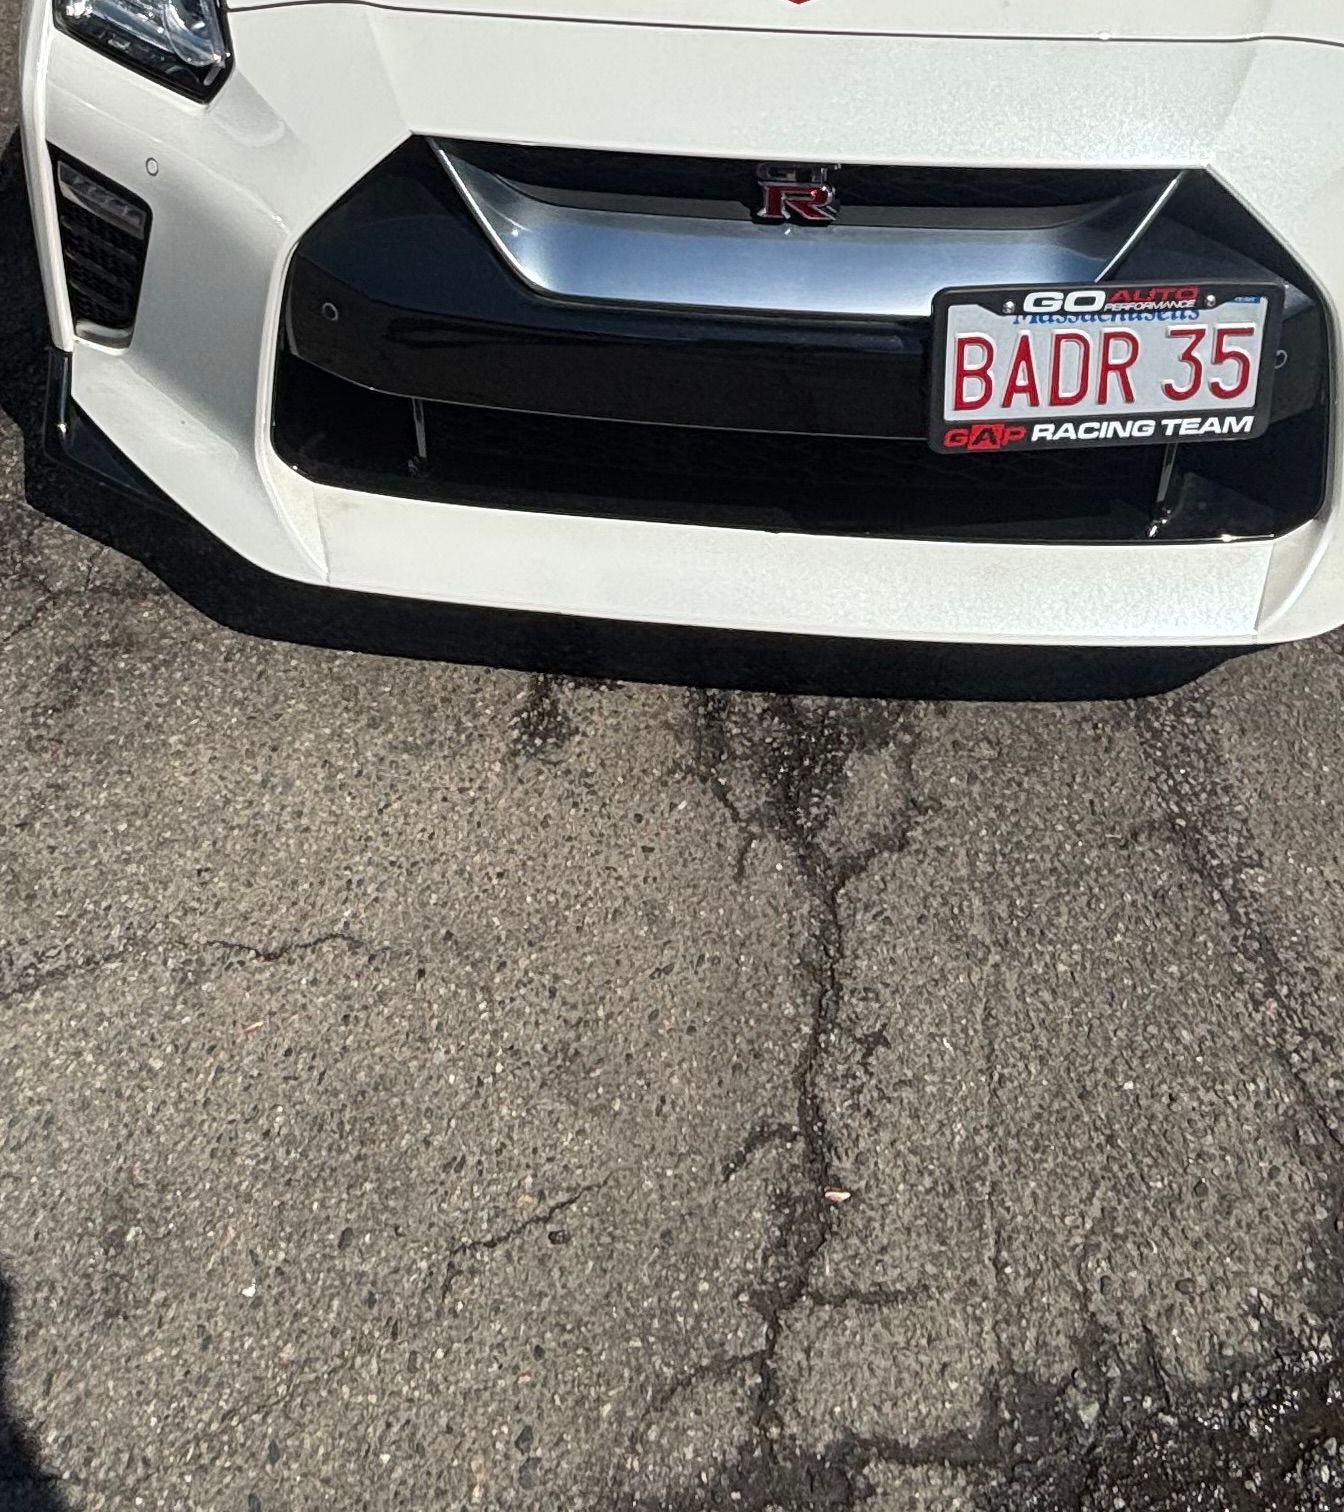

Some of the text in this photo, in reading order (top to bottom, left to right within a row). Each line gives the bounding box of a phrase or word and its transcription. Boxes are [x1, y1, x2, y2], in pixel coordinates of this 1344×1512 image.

[1023, 287, 1199, 312] GO AUTO
[1103, 299, 1197, 312] PERFORMANCE
[953, 325, 1257, 412] BADR 35
[943, 415, 1254, 450] GAP RACING TEAM
